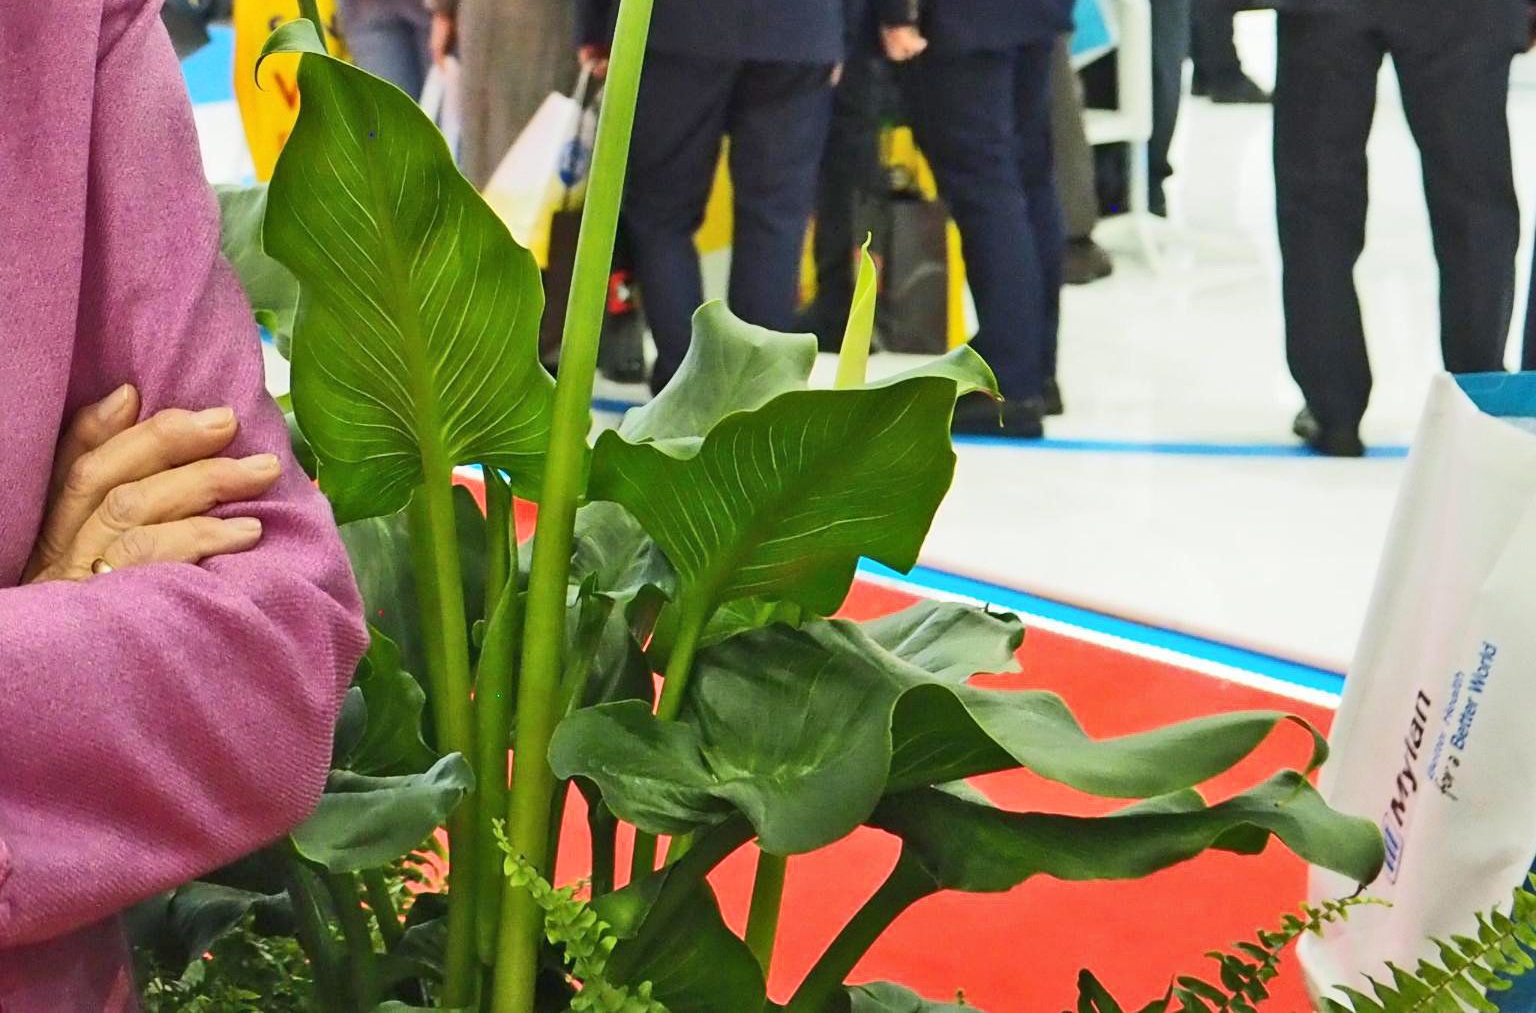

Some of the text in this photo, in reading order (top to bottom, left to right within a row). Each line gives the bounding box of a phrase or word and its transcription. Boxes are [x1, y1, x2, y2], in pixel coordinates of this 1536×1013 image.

[1390, 689, 1431, 827] Mylan
[1435, 766, 1458, 801] for
[1450, 696, 1478, 751] Better
[1468, 641, 1497, 694] World
